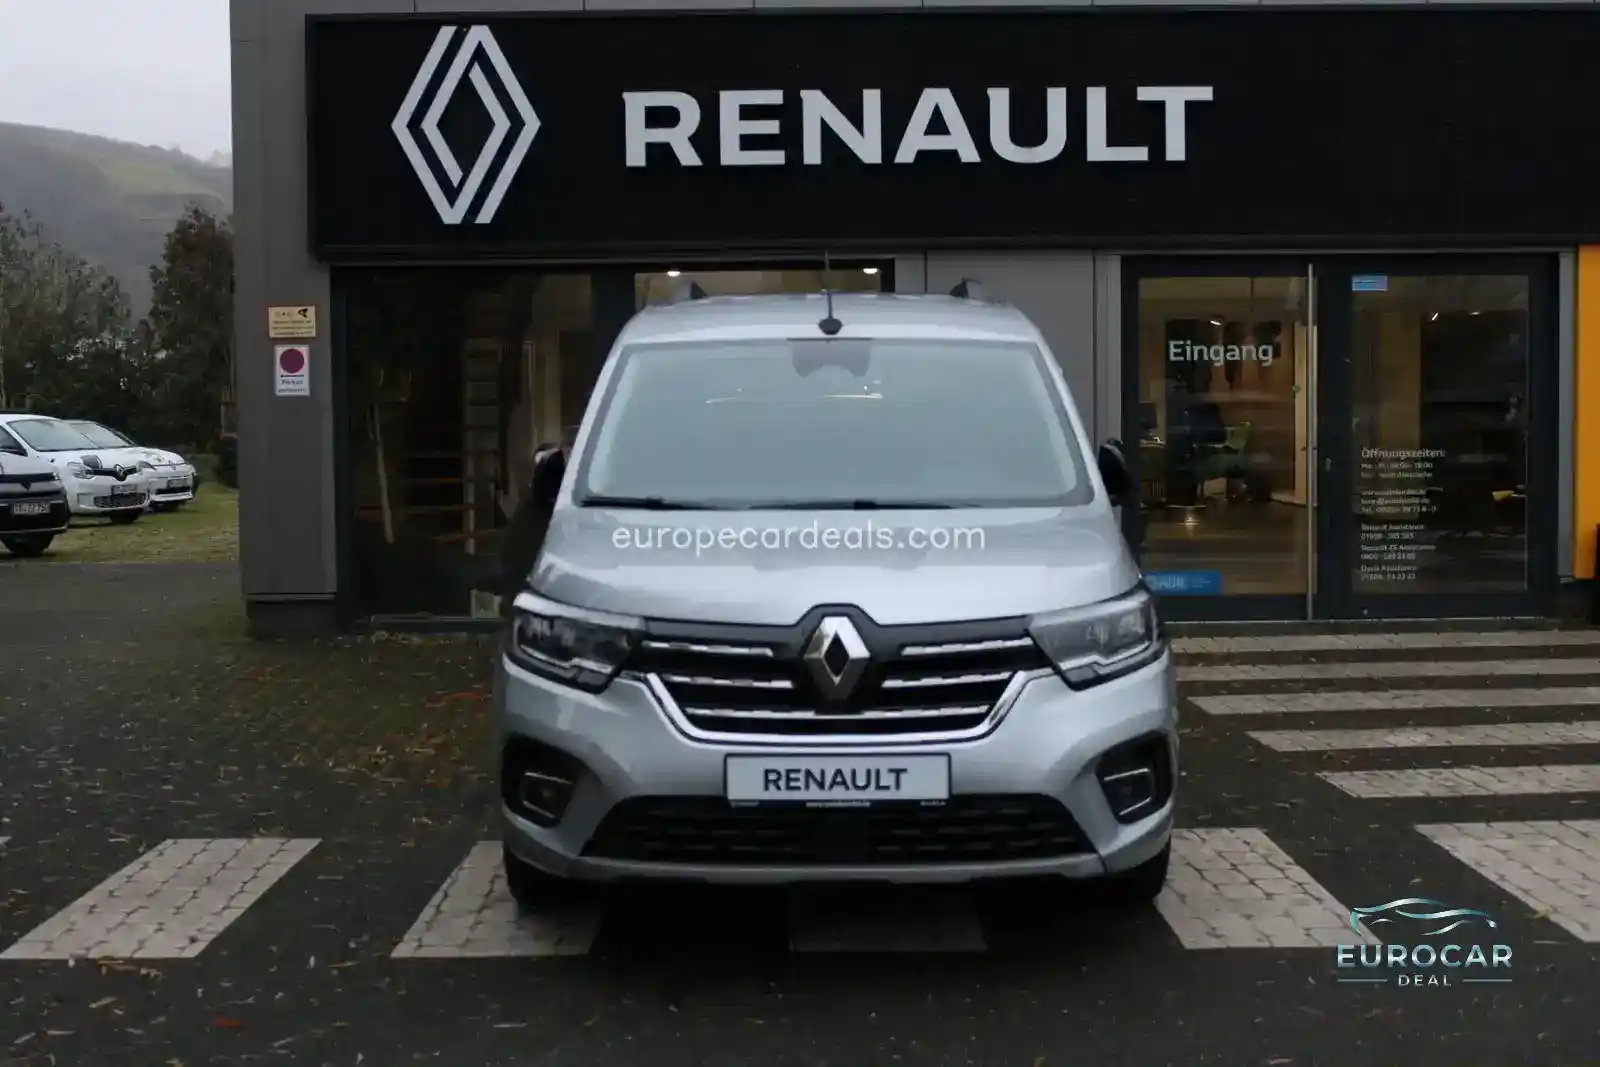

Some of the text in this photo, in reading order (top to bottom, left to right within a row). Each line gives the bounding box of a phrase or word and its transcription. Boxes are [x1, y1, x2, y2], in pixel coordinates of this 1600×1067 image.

[622, 86, 1214, 168] RENAULT
[1168, 340, 1273, 366] Eingang
[763, 768, 908, 792] RENAULT
